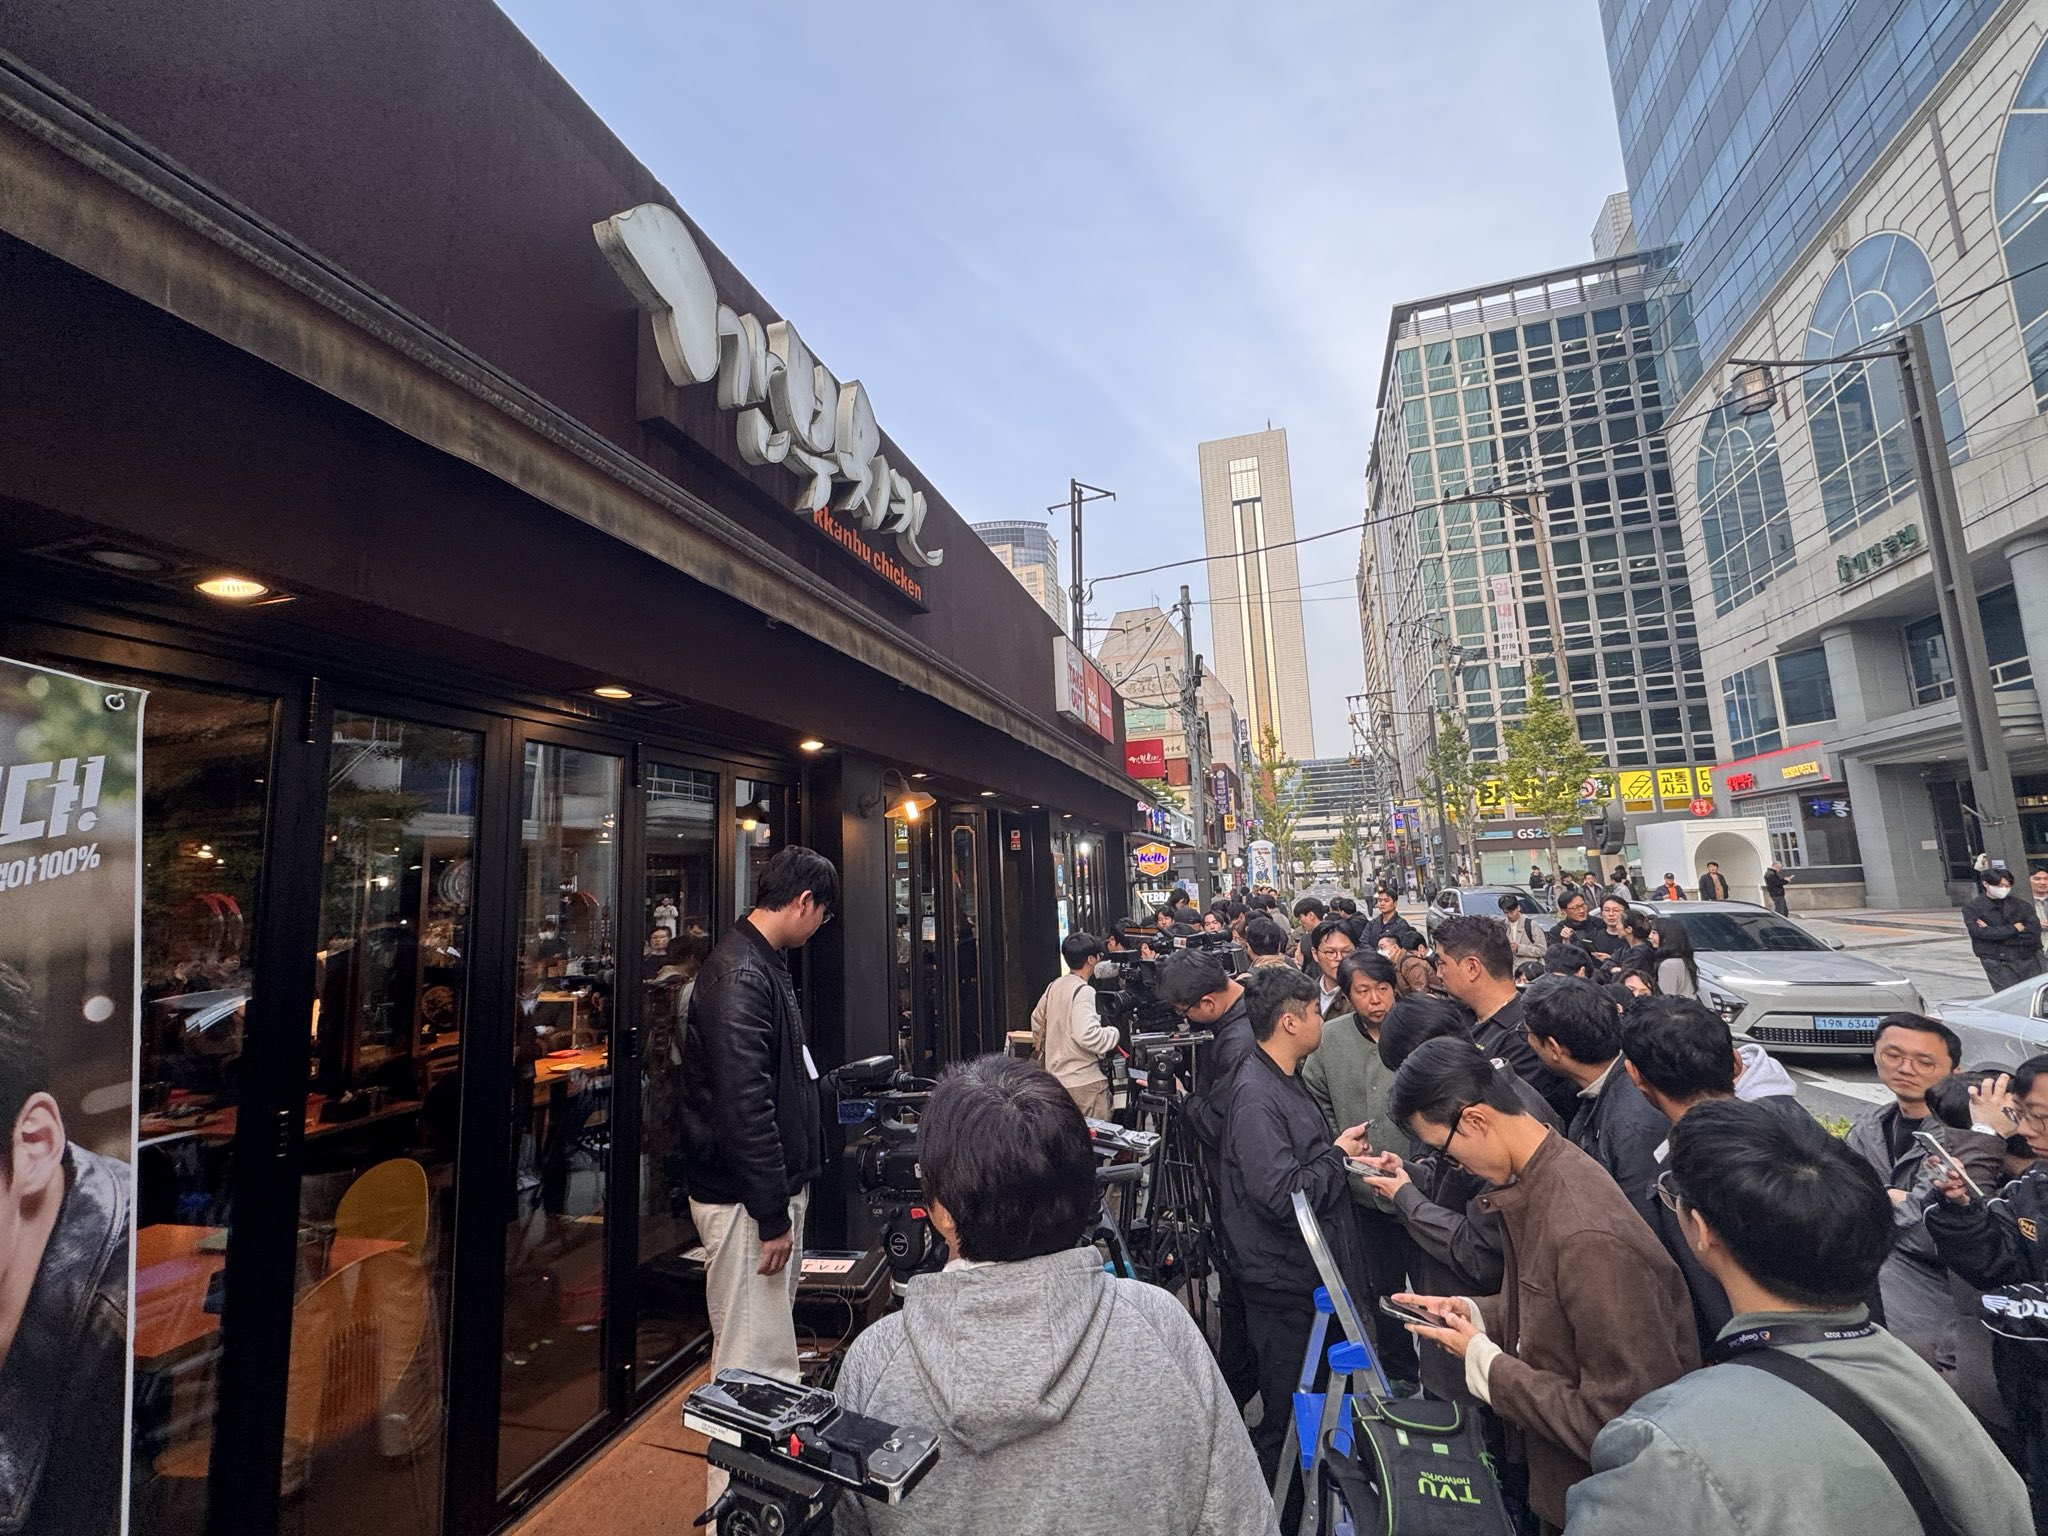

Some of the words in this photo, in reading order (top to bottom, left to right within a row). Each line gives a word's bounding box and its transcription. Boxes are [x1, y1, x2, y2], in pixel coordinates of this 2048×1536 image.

[813, 505, 871, 563] kkanbu
[873, 551, 922, 601] chicken
[1660, 772, 1687, 785] 교통
[1663, 784, 1690, 795] 사고
[0, 755, 105, 845] 다!
[1517, 828, 1551, 839] GS25
[1139, 853, 1168, 865] Kelly
[1847, 1018, 1875, 1029] 6344
[1420, 1471, 1471, 1485] networks
[1418, 1478, 1481, 1505] TVU
